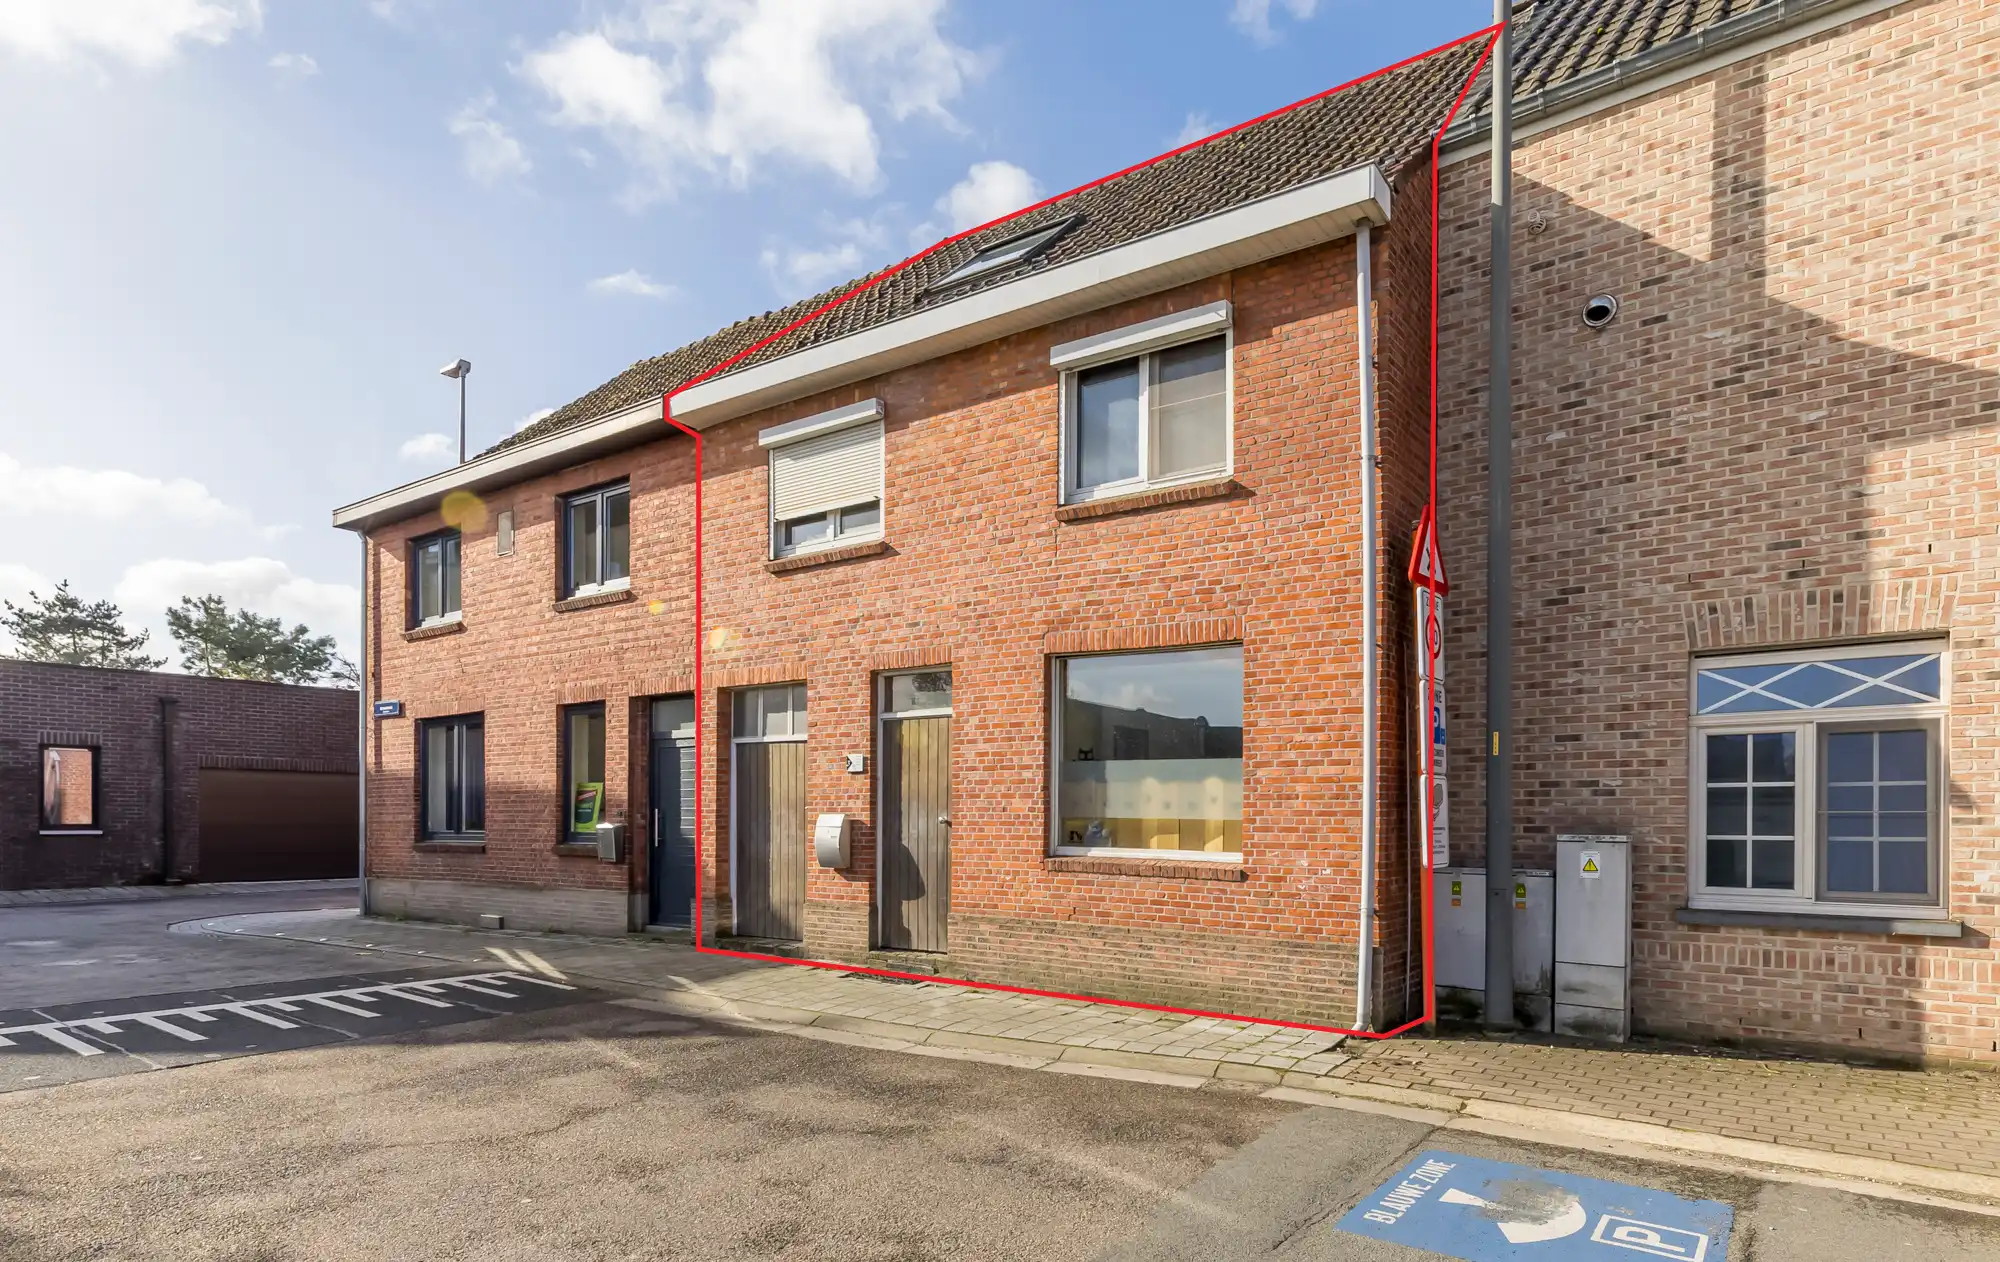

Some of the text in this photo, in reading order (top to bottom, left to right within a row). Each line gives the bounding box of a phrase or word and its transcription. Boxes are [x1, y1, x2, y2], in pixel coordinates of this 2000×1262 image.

[1363, 1159, 1456, 1224] BLAUWE ZONE
[1612, 1226, 1685, 1253] P
